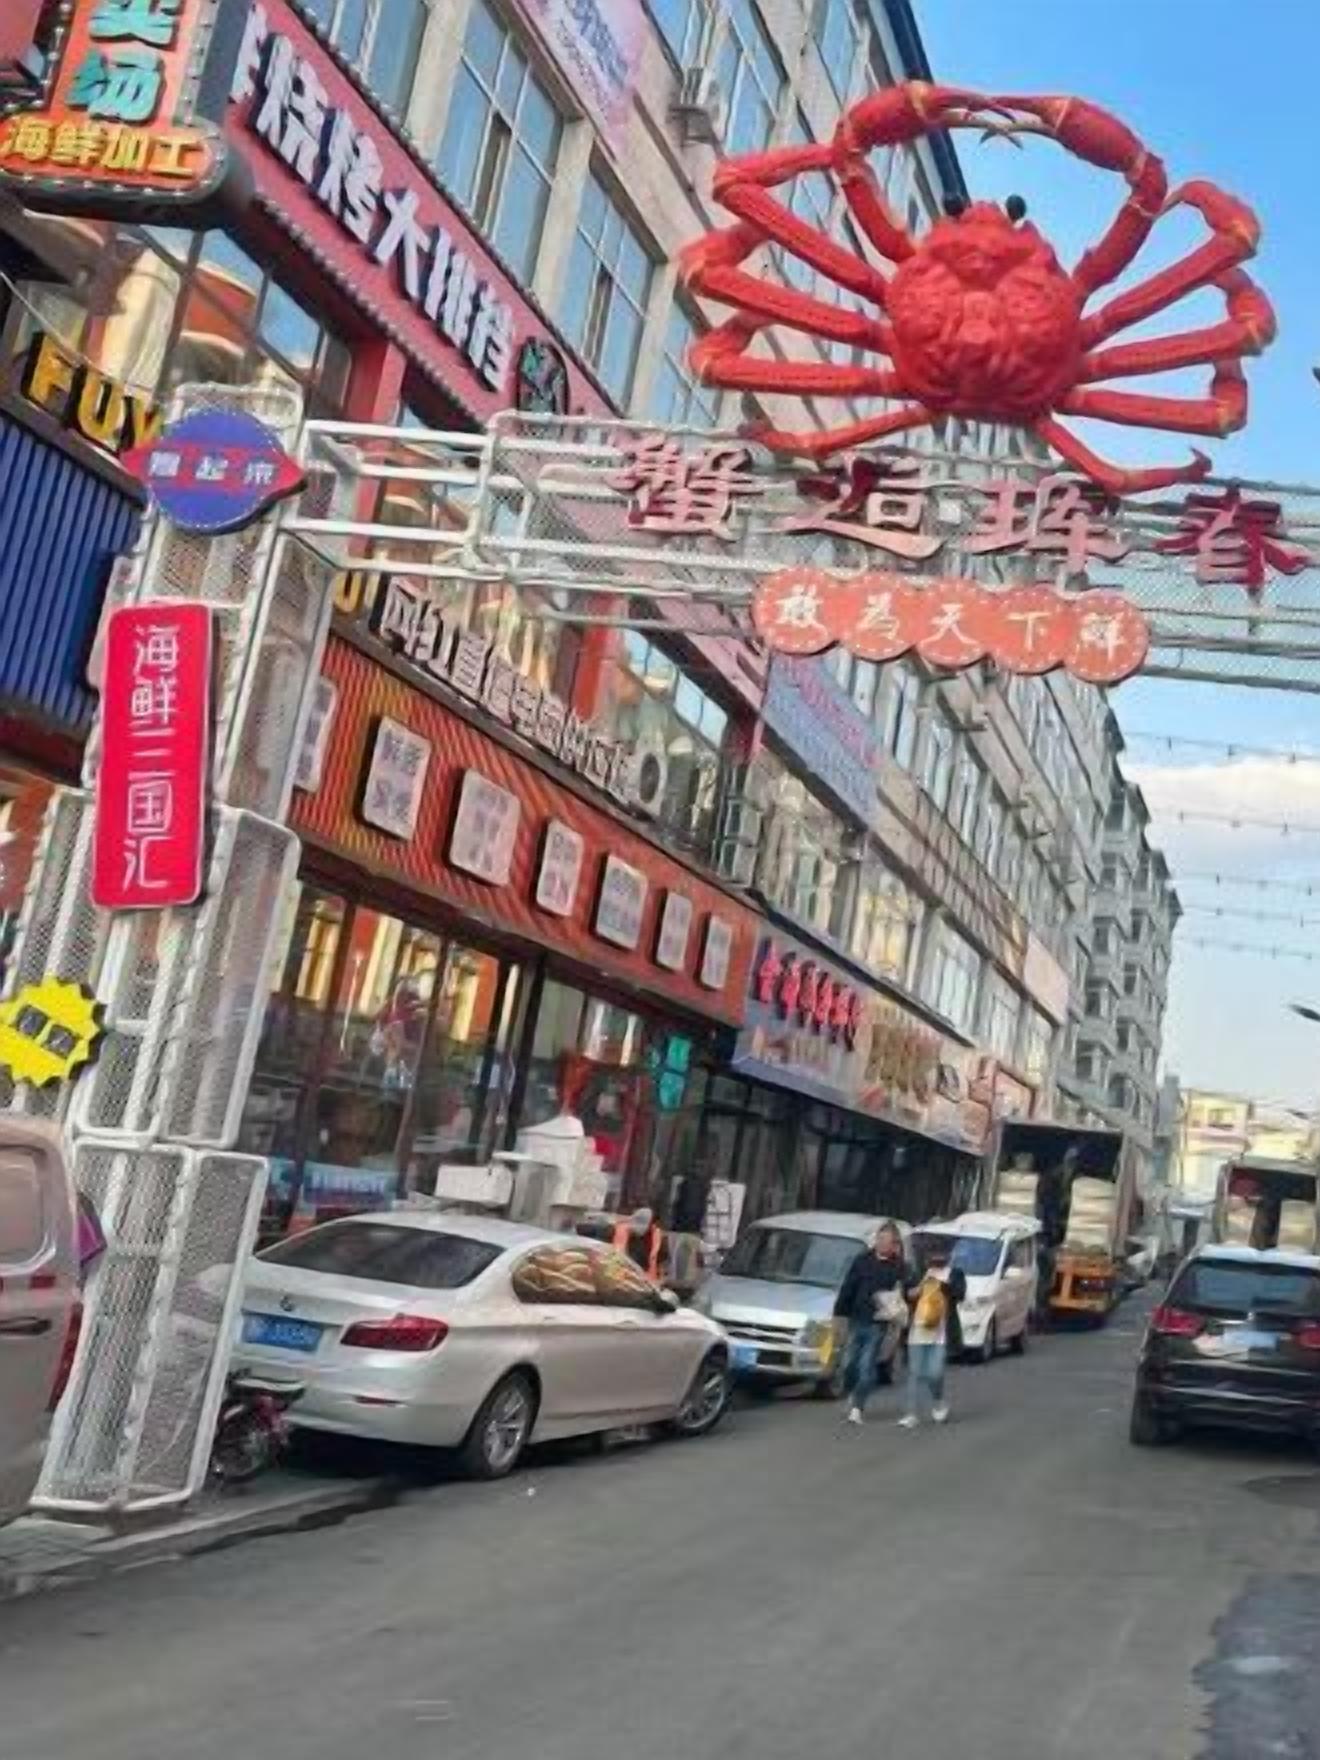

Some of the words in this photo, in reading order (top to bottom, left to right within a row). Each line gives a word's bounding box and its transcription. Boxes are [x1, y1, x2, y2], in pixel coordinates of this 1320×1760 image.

[2, 117, 204, 178] 海鲜加工
[122, 622, 180, 892] 海鲜三国汇
